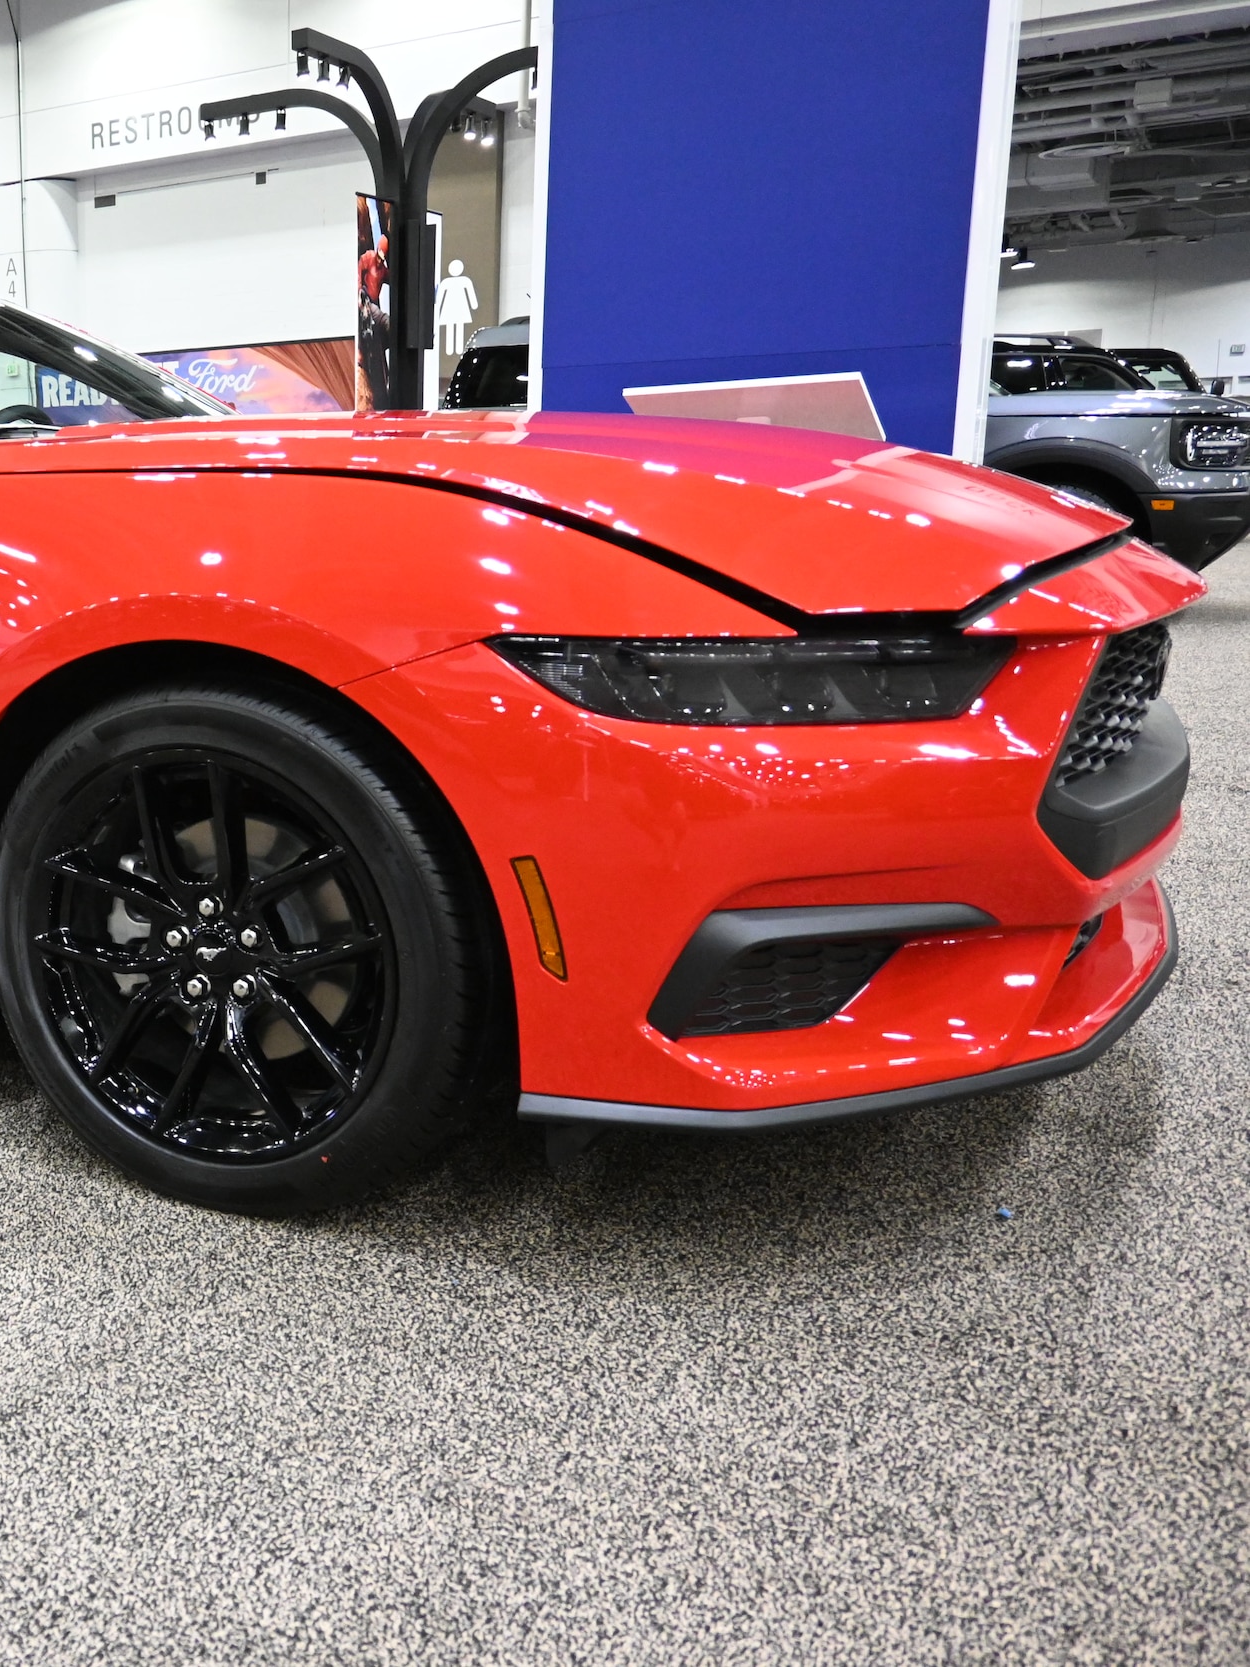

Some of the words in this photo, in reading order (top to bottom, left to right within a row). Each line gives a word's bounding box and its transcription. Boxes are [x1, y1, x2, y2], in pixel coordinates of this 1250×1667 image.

[6, 257, 17, 277] A
[8, 280, 16, 298] 4
[41, 374, 121, 408] READ
[187, 358, 256, 394] Ford
